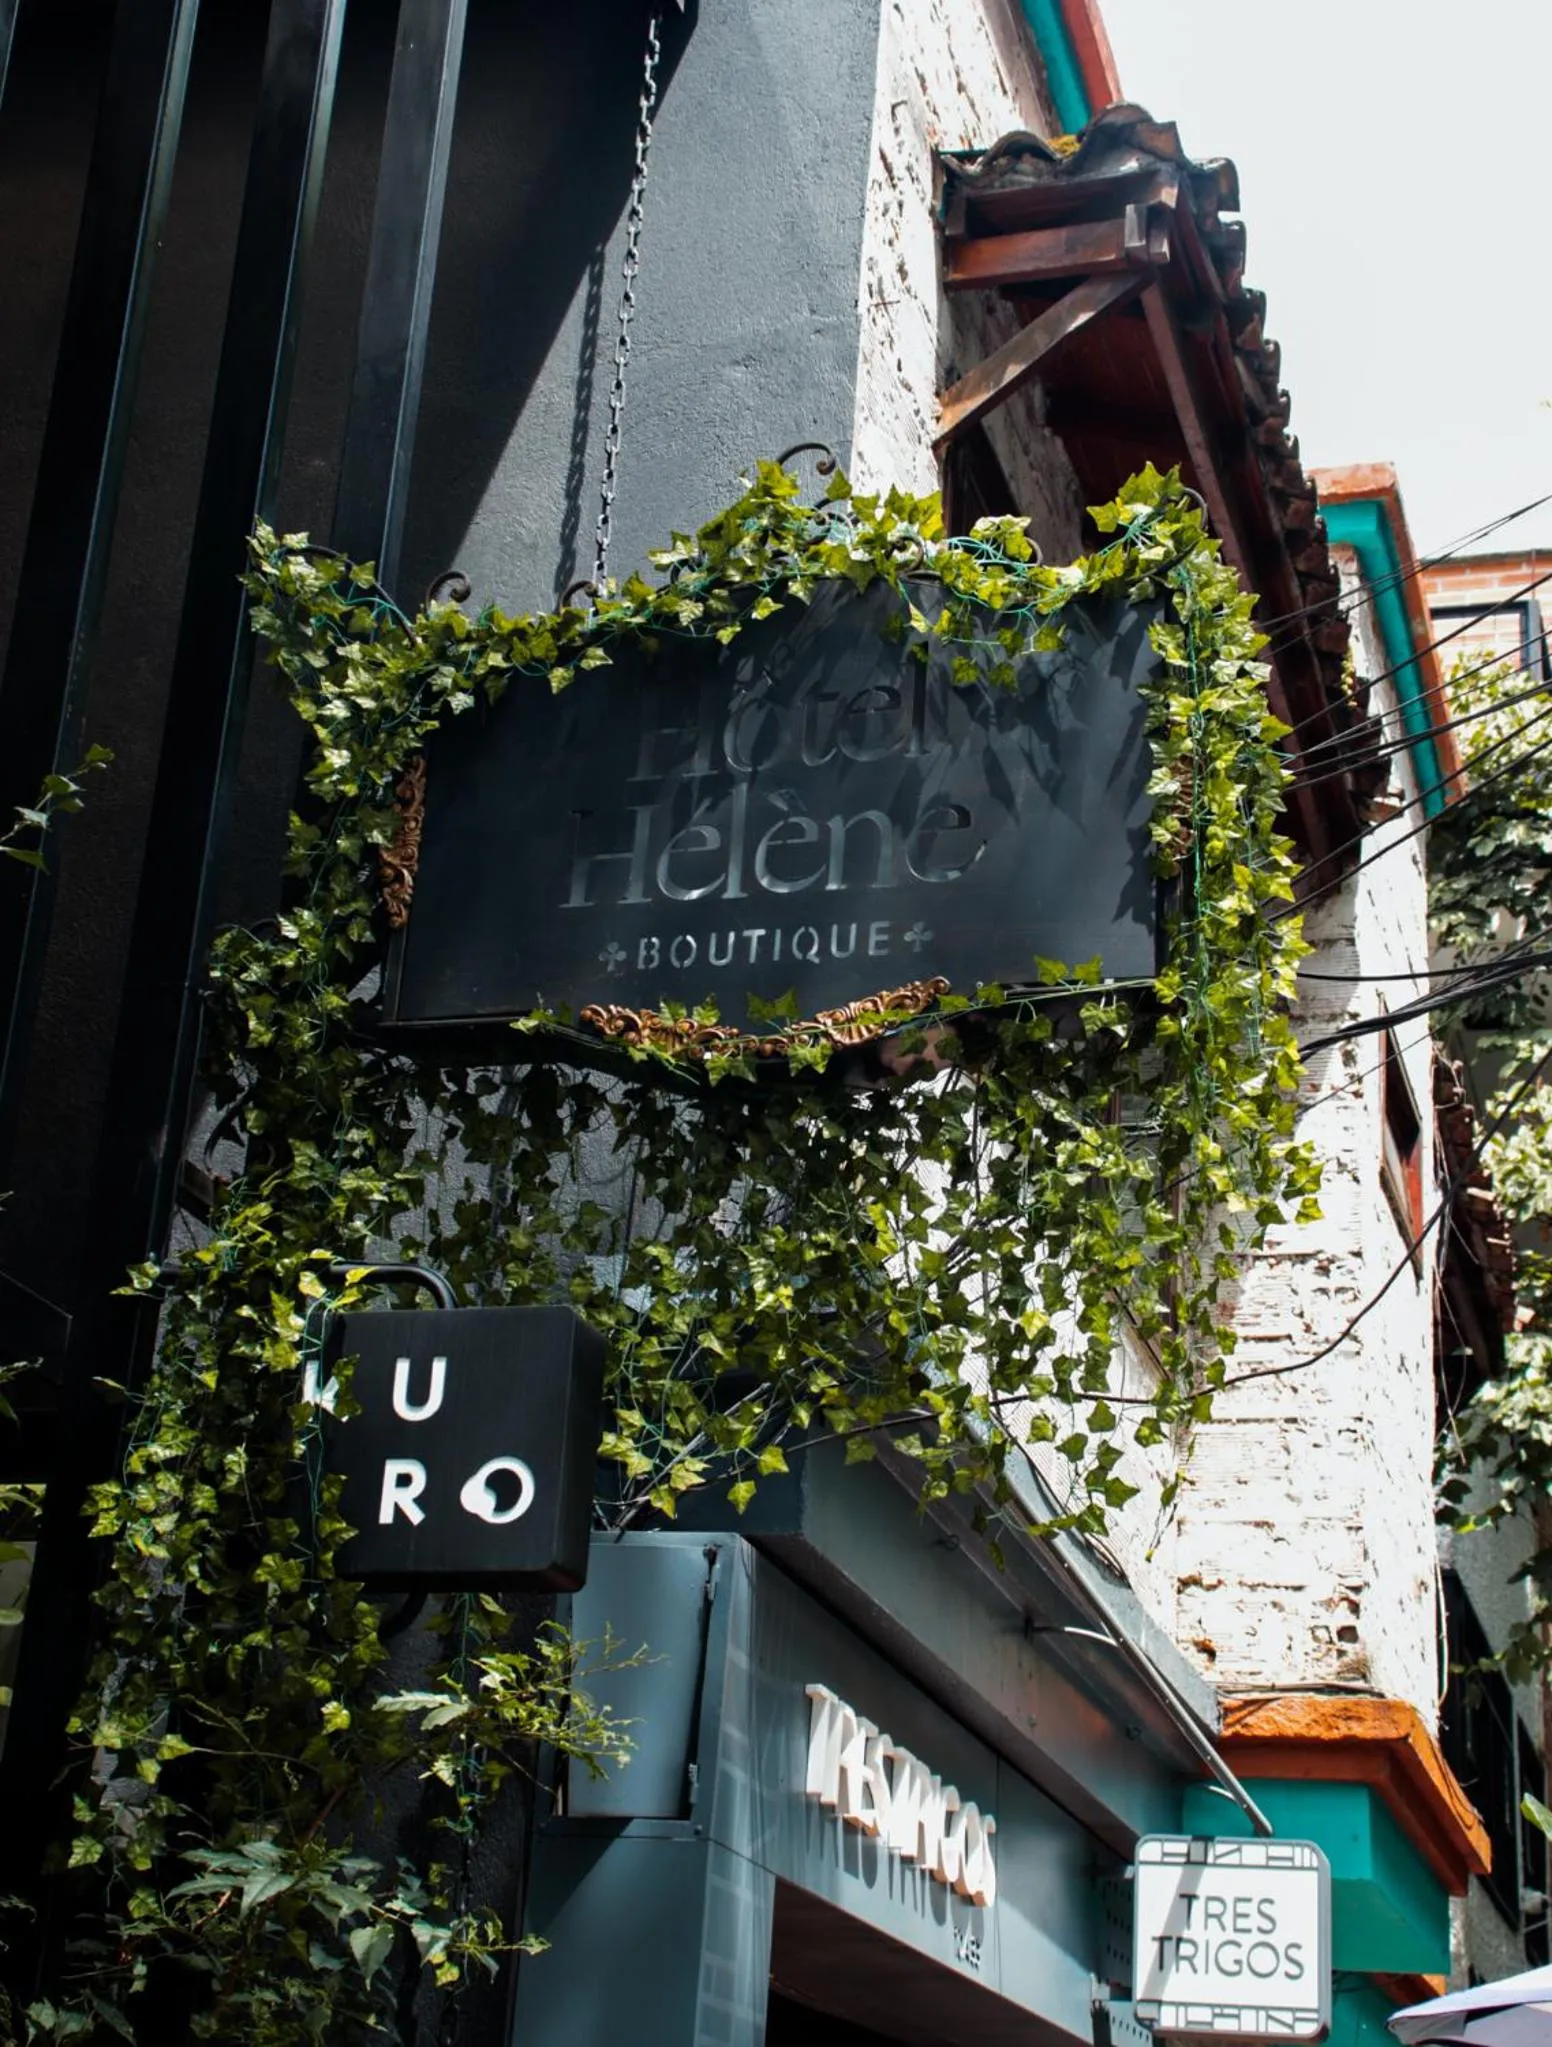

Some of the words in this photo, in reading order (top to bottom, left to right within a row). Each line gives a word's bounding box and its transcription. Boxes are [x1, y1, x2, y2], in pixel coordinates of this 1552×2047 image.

[636, 920, 892, 969] BOUTIQUE
[1179, 1893, 1277, 1935] TRES
[1151, 1935, 1305, 1981] TRIGOS
